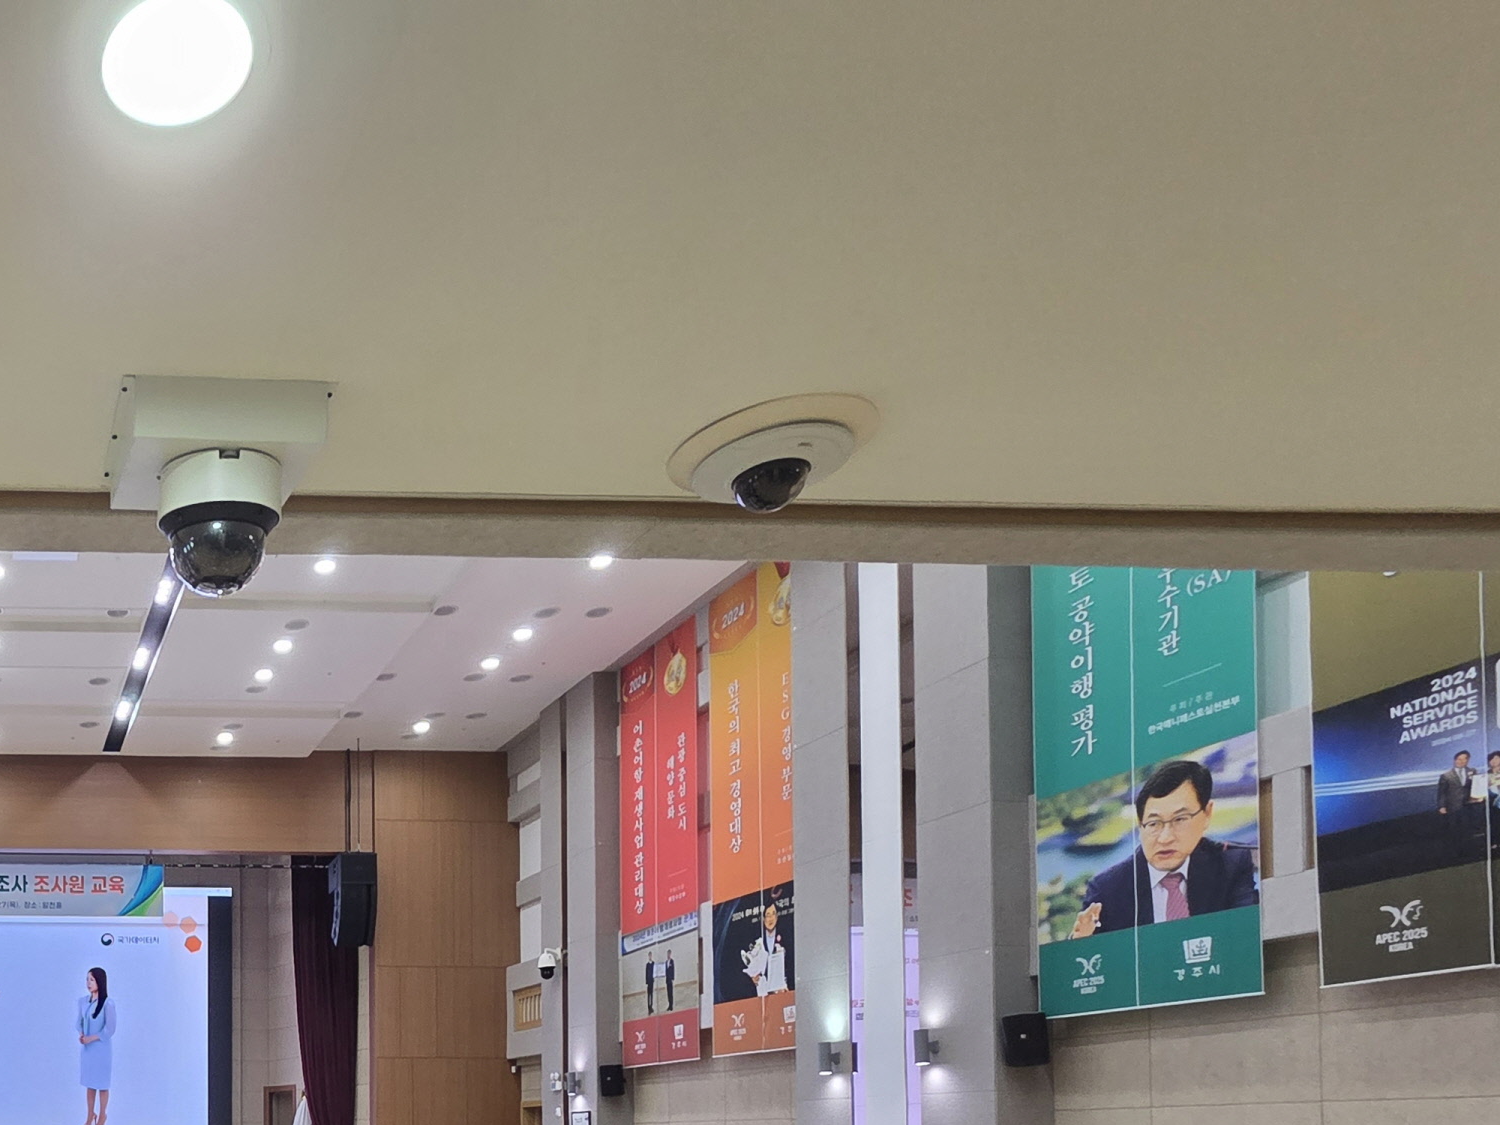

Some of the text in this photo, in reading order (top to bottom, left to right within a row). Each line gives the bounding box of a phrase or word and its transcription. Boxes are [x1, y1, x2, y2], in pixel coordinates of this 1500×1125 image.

[721, 602, 745, 629] 2024
[1067, 595, 1096, 700] 공약이행
[628, 671, 647, 694] 2024
[1430, 666, 1477, 692] 2024
[1389, 682, 1479, 719] NATIONAL
[1402, 695, 1479, 728] SERVICE
[781, 671, 792, 801] ESG 경영 부문
[1070, 704, 1098, 757] 평가
[1399, 710, 1479, 744] AWARDS
[727, 678, 743, 854] 한국의 최고 경영대상
[633, 785, 644, 849] 재생사업
[677, 801, 687, 831] 도시
[33, 875, 85, 894] 조사원
[91, 875, 125, 895] 교육
[633, 851, 644, 915] 관리대상
[1375, 926, 1428, 945] APEC 2025
[1173, 963, 1221, 982] 경주시
